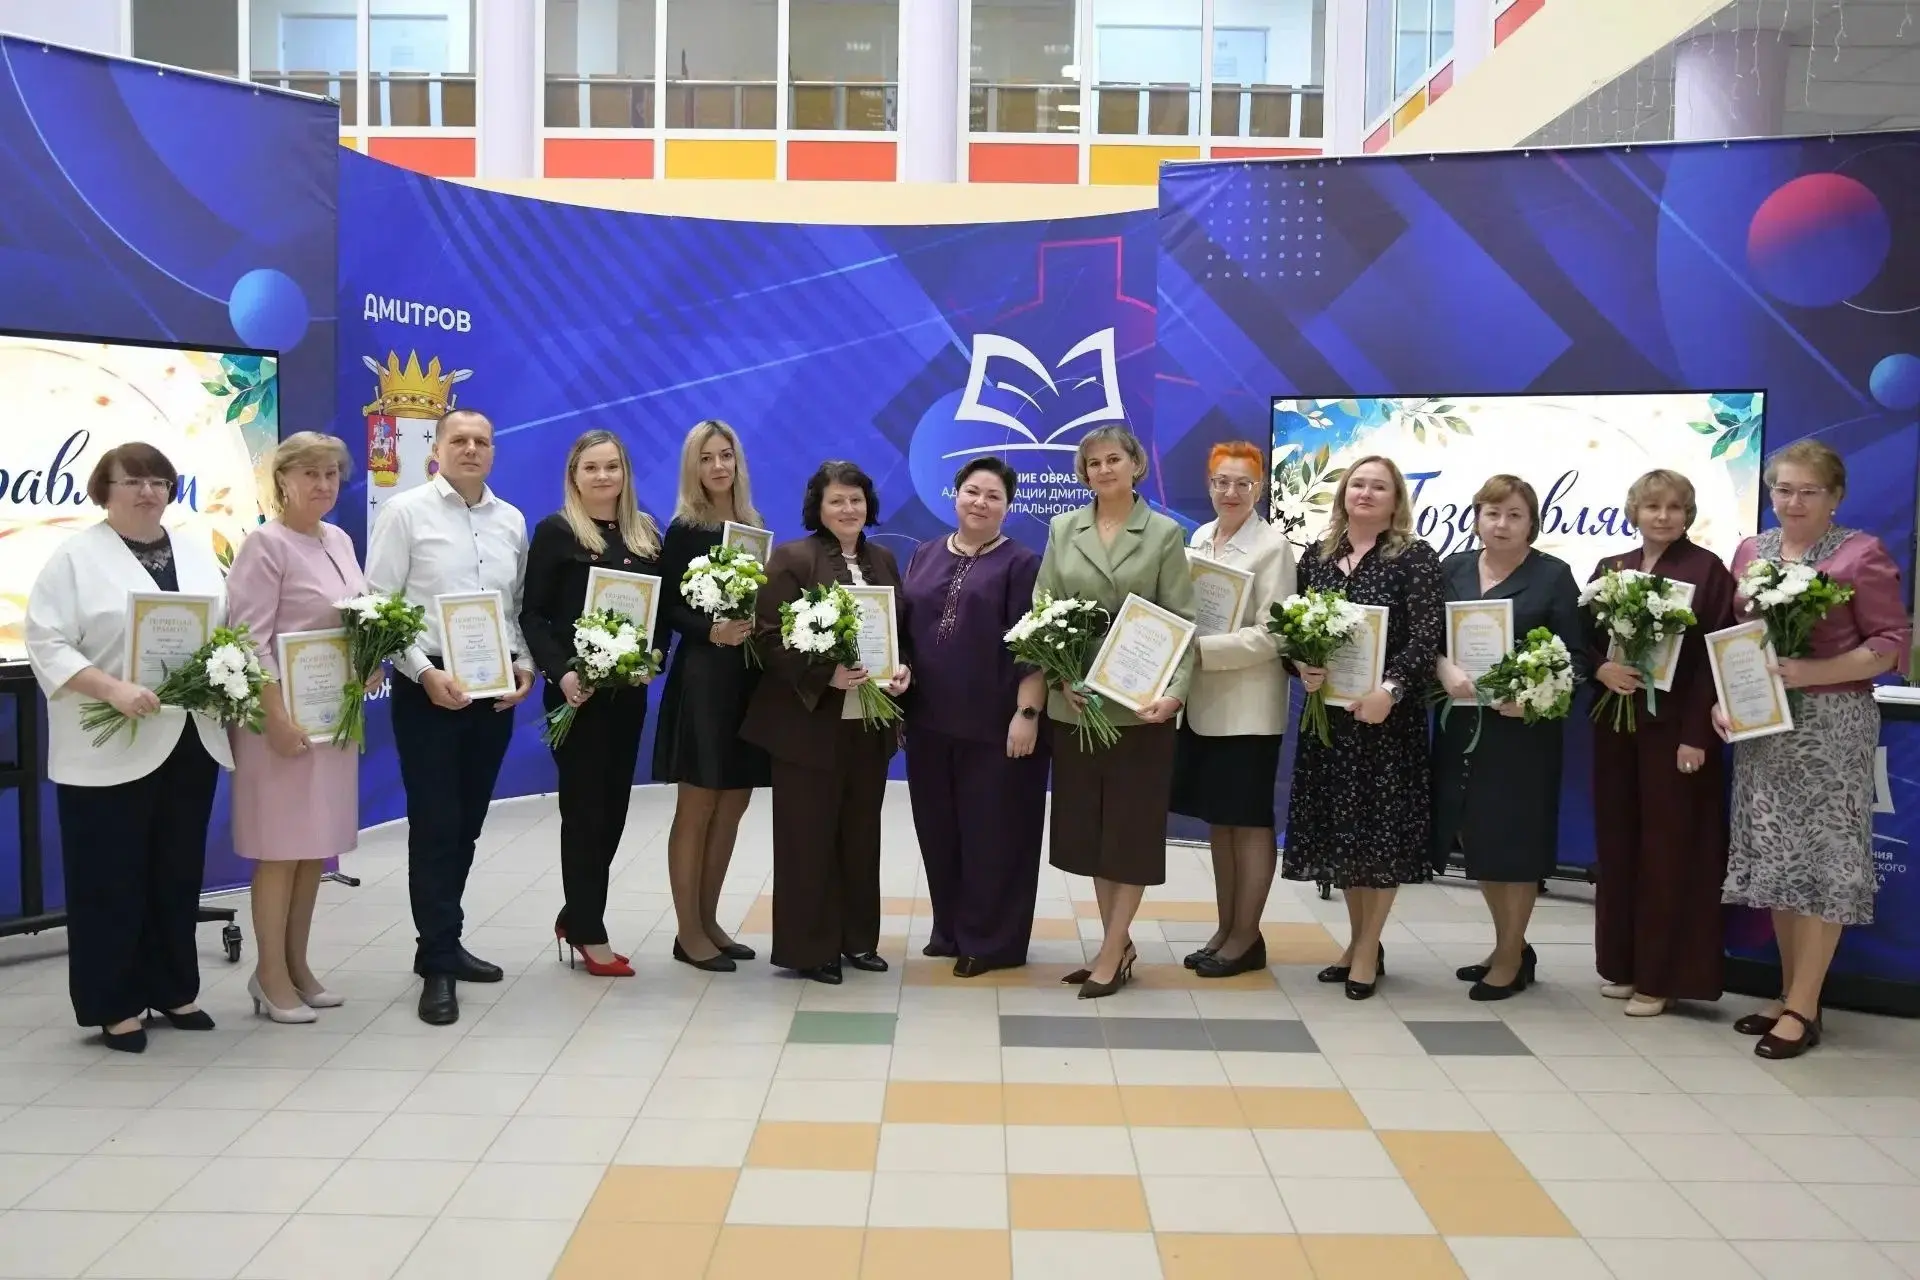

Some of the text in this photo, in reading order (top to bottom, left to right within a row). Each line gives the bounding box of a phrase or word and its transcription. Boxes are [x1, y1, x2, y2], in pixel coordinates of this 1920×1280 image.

[364, 293, 472, 333] ДМИТРОВ
[1039, 473, 1079, 484] ОБРАЗ
[1048, 488, 1098, 501] ДМИТРО
